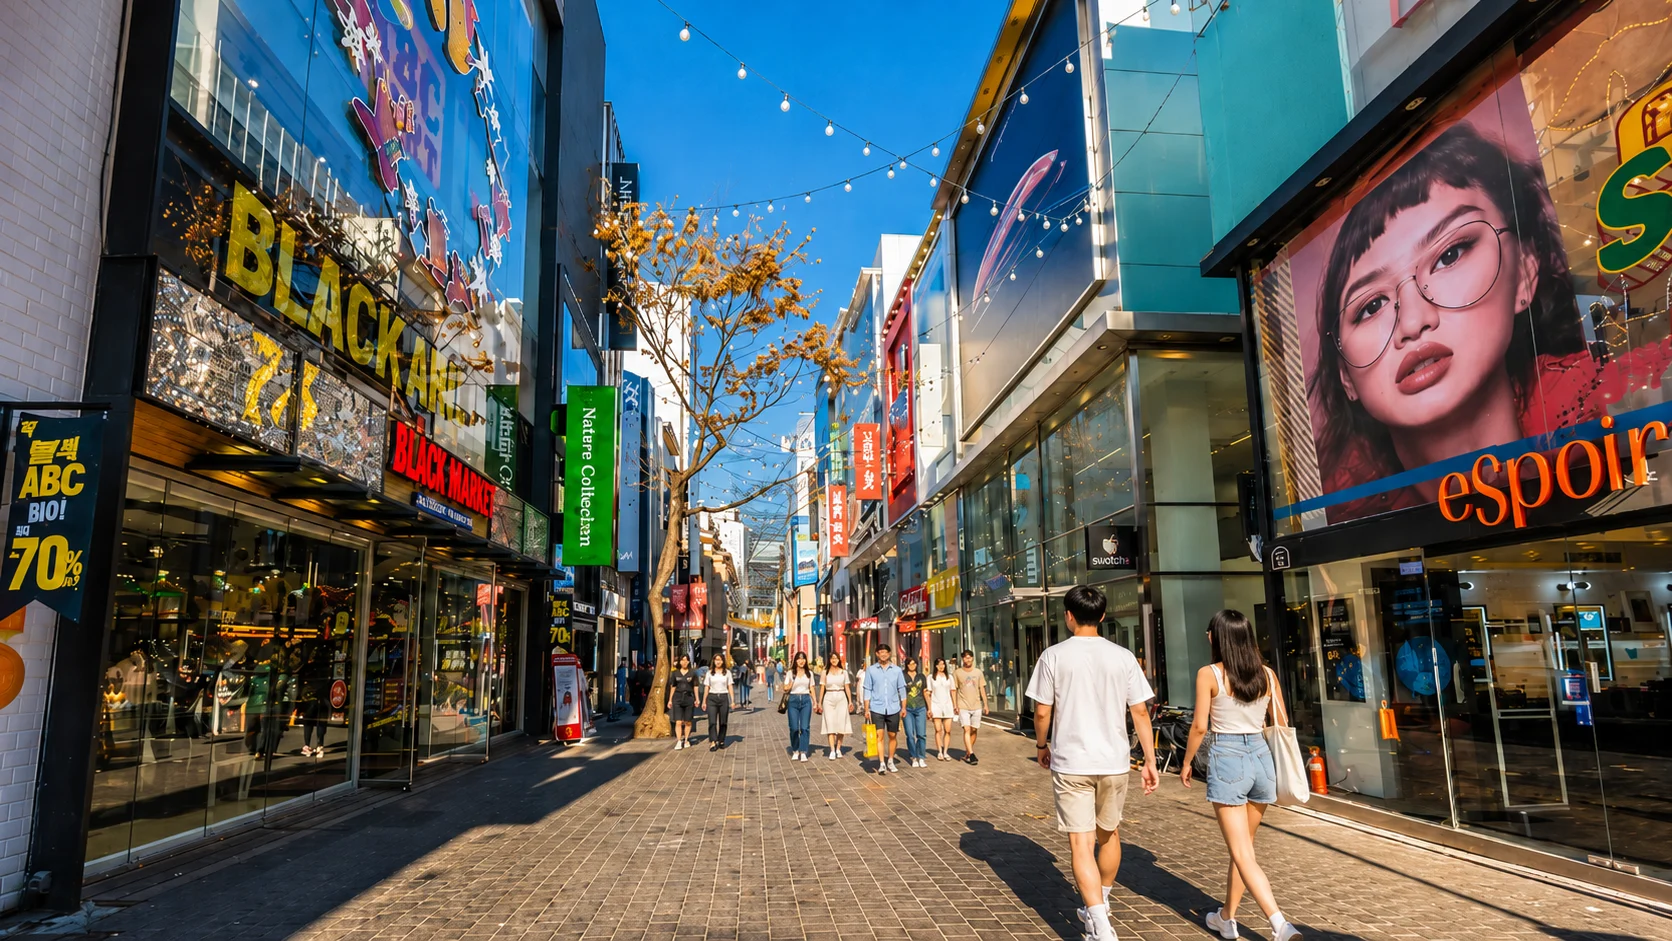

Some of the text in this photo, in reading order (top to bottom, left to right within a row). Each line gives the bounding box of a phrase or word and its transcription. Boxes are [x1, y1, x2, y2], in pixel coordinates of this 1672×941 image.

[225, 180, 406, 392] BLACK
[18, 462, 86, 499] ABC
[393, 421, 448, 495] BLACK
[448, 457, 496, 519] MARKET
[1438, 415, 1669, 529] espoir
[28, 499, 67, 523] BIO!
[551, 607, 570, 617] ABC
